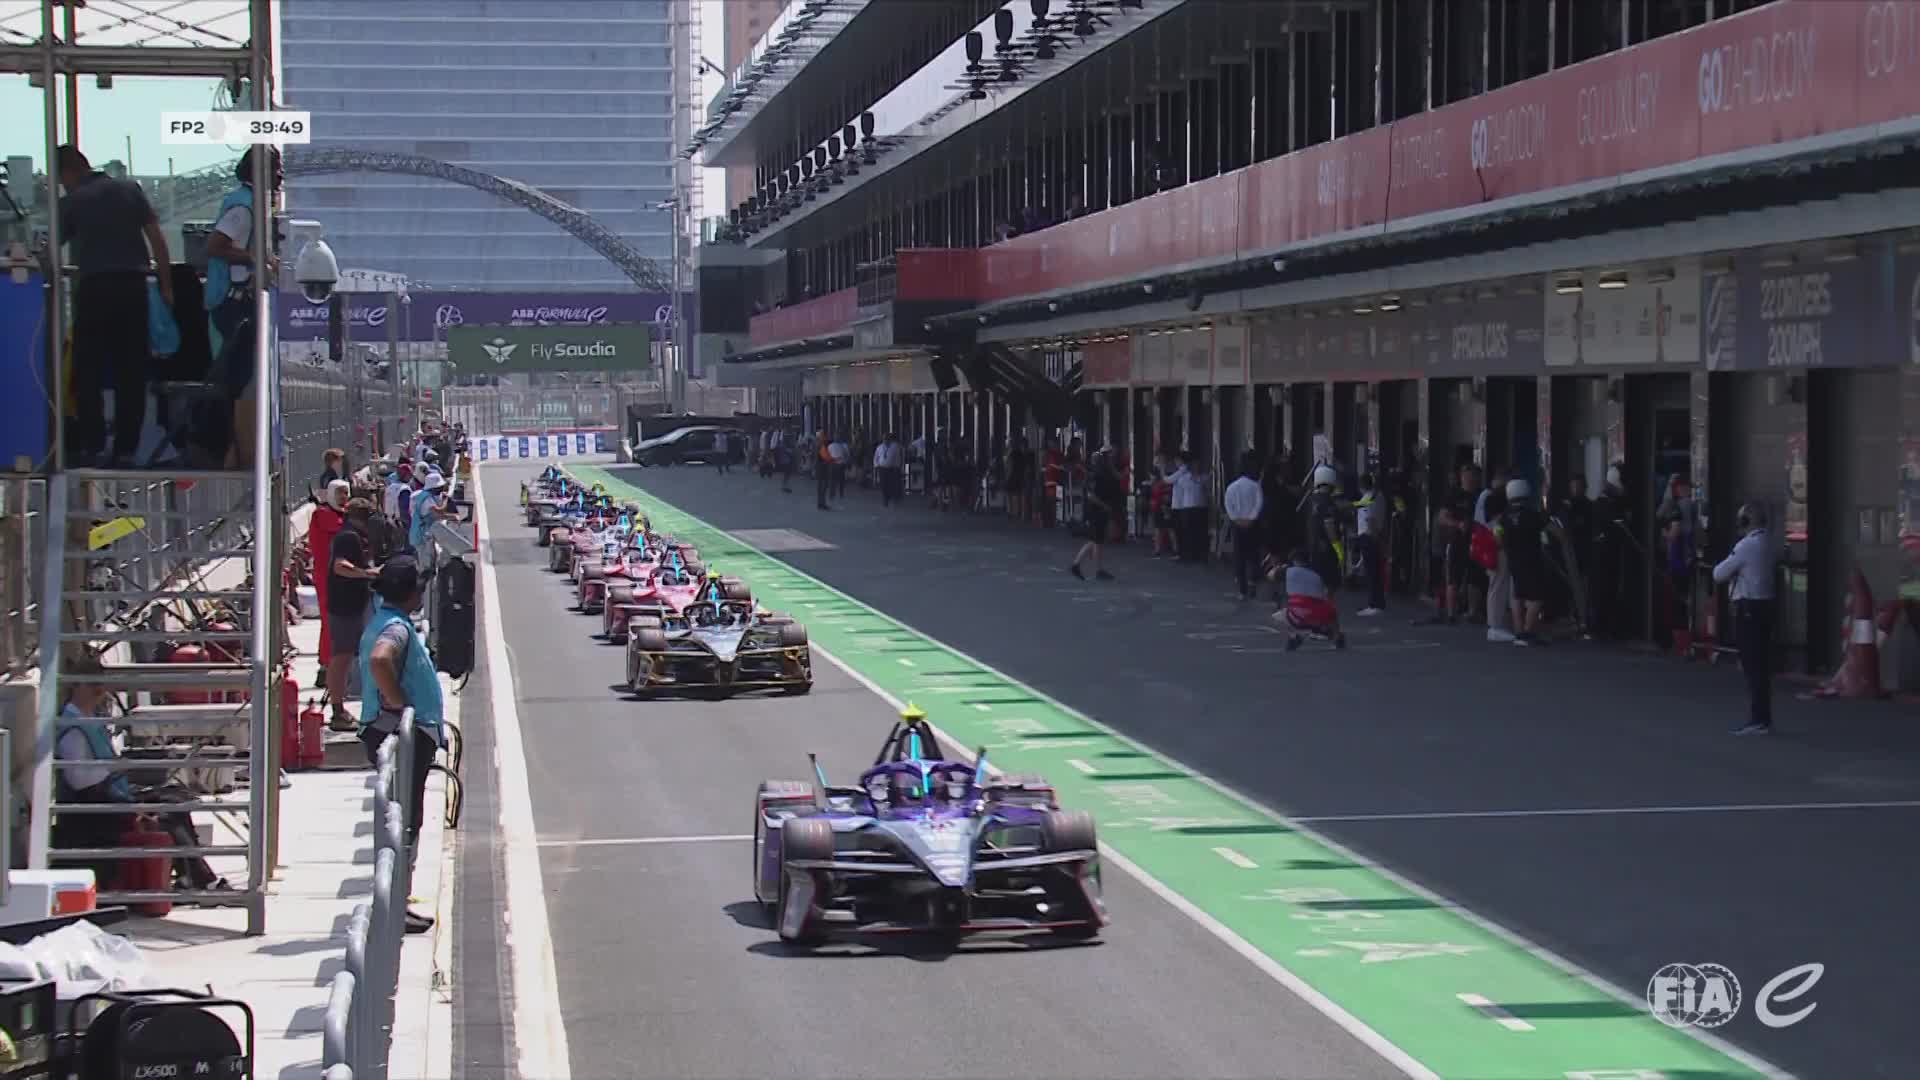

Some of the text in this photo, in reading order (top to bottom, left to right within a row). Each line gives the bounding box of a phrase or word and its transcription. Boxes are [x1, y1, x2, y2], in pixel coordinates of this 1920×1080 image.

[1578, 86, 1599, 145] GO
[512, 310, 534, 318] ABB
[535, 308, 589, 320] FORMULA
